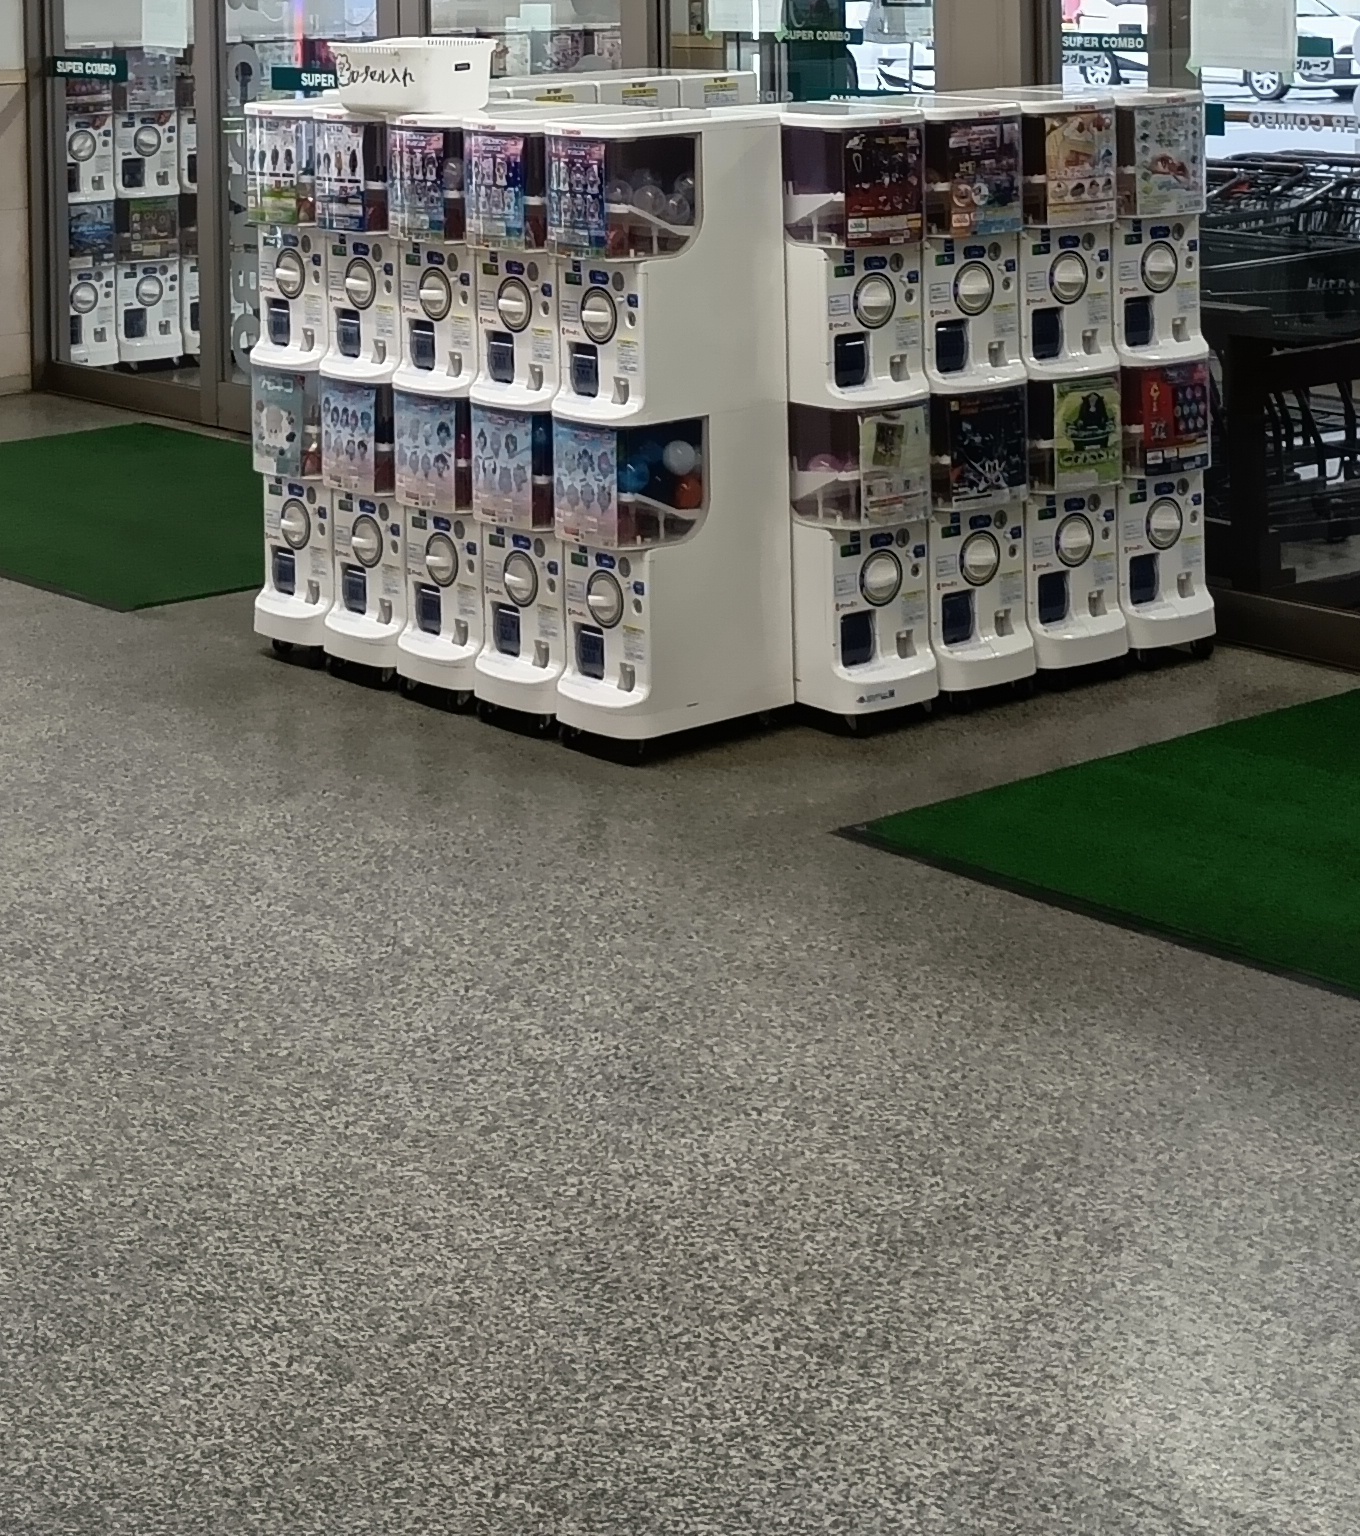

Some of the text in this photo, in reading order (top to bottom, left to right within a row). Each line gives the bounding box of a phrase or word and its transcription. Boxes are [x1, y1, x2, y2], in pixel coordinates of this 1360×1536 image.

[816, 31, 851, 42] COMBO
[1062, 35, 1144, 49] SUPER COMBO
[56, 60, 117, 76] SUPER COMBO
[300, 72, 335, 87] SUPER
